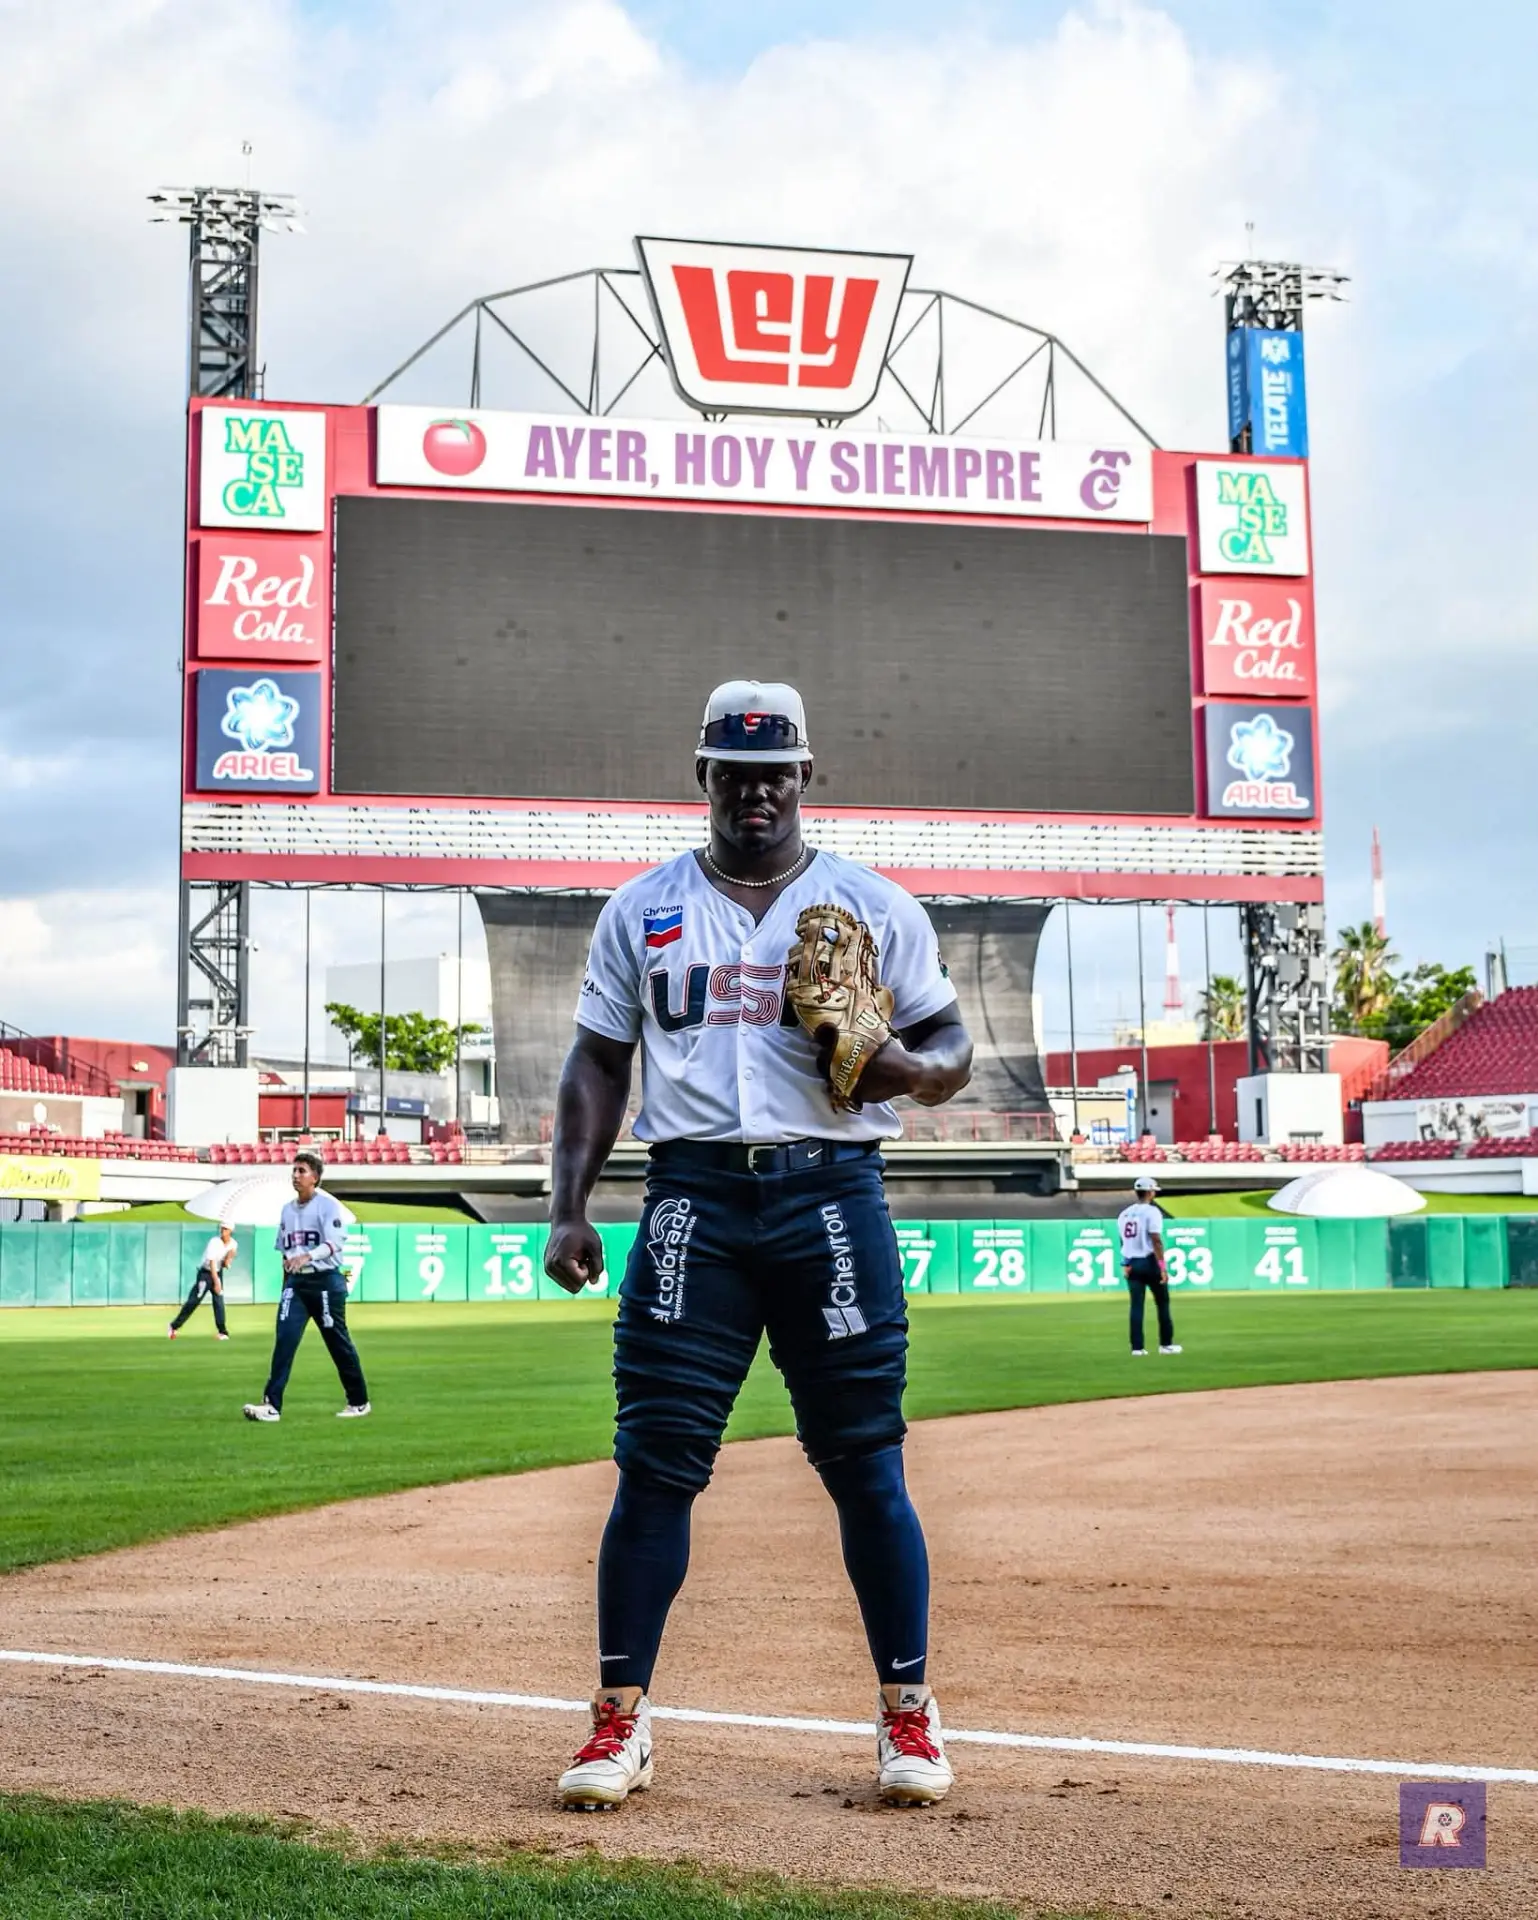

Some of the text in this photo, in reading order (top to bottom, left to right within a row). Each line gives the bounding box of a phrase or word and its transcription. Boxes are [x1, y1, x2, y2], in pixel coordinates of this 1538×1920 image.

[1261, 366, 1289, 451] TECATE
[524, 424, 1043, 502] AYER, HOY Y SIEMPRE
[204, 554, 318, 609] Red
[1207, 598, 1306, 649] Red
[215, 754, 307, 778] ARIEL
[1226, 783, 1303, 806] ARIEL
[643, 904, 684, 917] Chevron
[835, 1039, 864, 1087] Wilson
[655, 1198, 691, 1306] colorado
[820, 1203, 856, 1307] Chevron
[972, 1248, 1026, 1287] 28
[1067, 1248, 1120, 1287] 31
[1166, 1247, 1214, 1286] 33
[1254, 1246, 1309, 1285] 41
[418, 1254, 445, 1296] 9
[482, 1254, 534, 1295] 13
